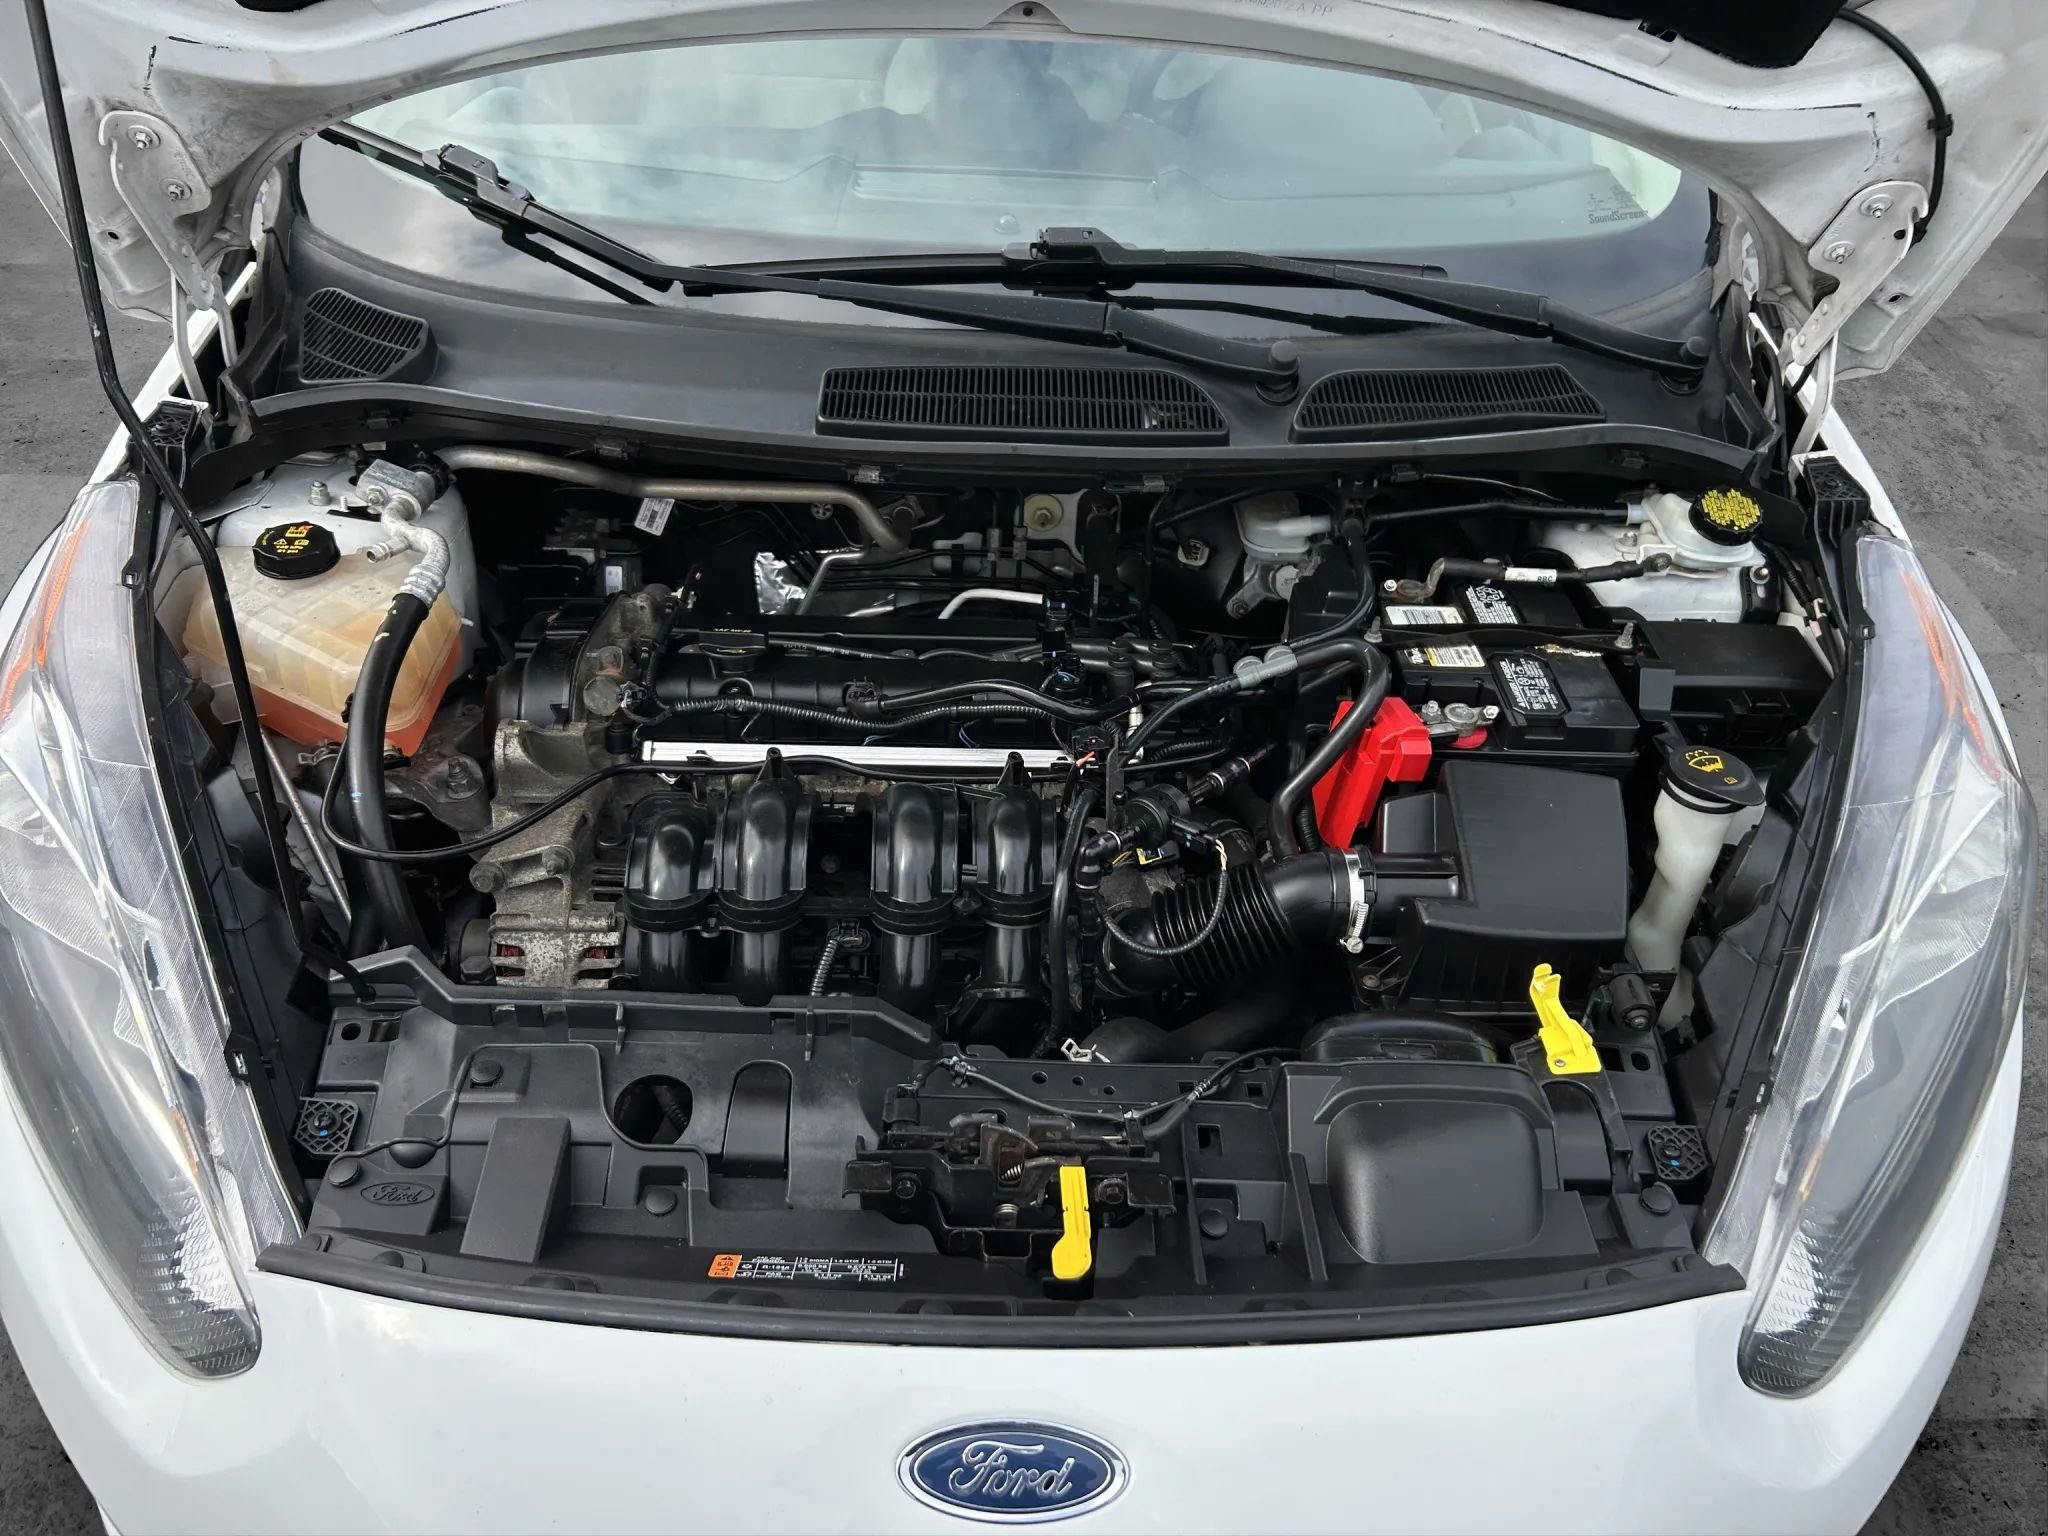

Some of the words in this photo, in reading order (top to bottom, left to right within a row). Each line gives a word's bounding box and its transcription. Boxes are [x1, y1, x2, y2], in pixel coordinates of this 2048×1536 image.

[1588, 210, 1648, 224] SoundScreen
[373, 1185, 423, 1202] Ford
[949, 1440, 1075, 1497] Ford
